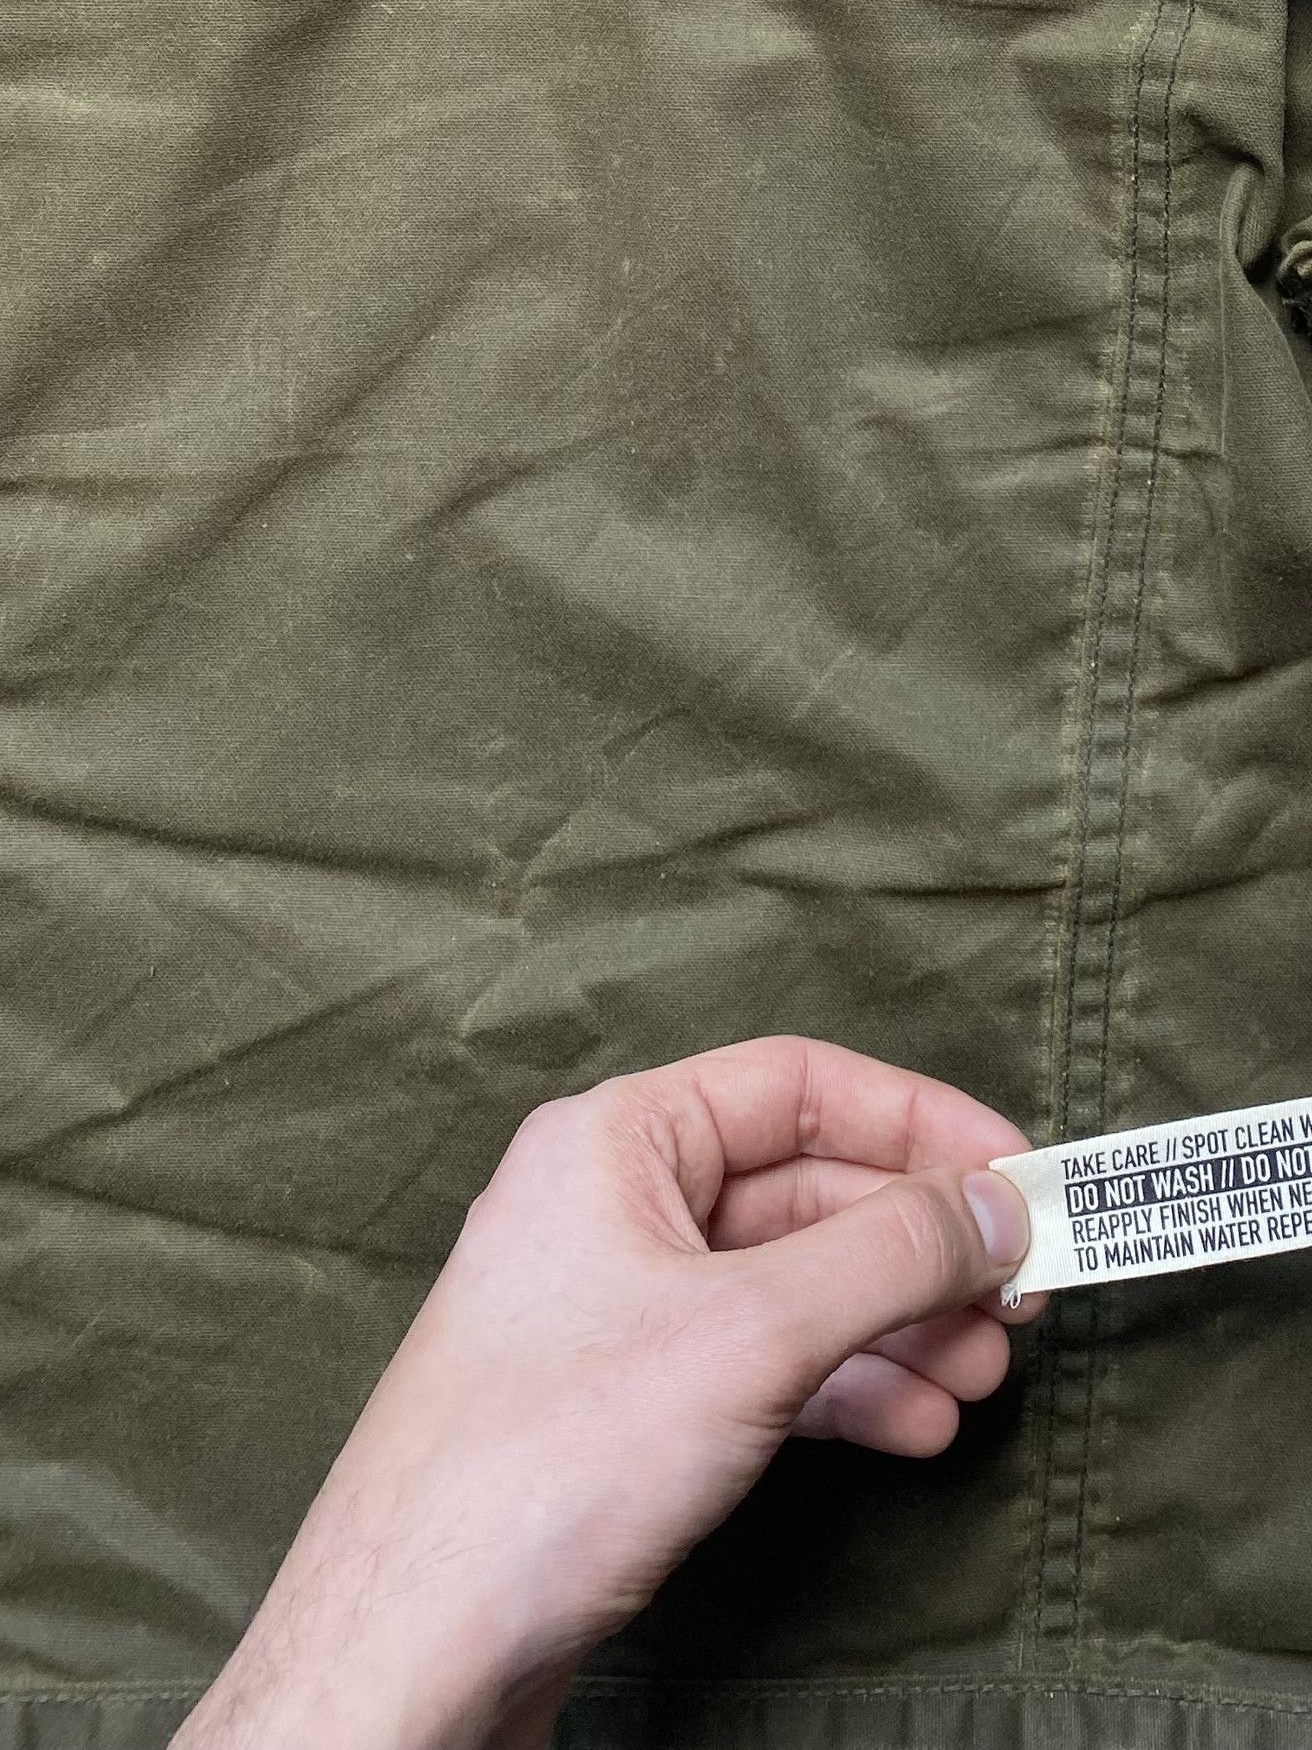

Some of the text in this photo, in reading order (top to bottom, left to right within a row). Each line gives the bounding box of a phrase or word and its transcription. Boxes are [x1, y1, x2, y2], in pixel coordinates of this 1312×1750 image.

[1061, 1152, 1107, 1180] TAKE
[1111, 1141, 1161, 1171] CARE
[1165, 1137, 1178, 1163] //
[1181, 1129, 1229, 1160] SPOT
[1235, 1117, 1295, 1150] CLEAN
[1068, 1183, 1099, 1215] DO
[1104, 1174, 1147, 1208] NOT
[1150, 1162, 1215, 1200] WASH
[1220, 1157, 1235, 1189] //
[1240, 1153, 1272, 1185] DO
[1072, 1207, 1153, 1244] REAPPLY
[1159, 1196, 1223, 1231] FINISH
[1226, 1186, 1284, 1218] WHEN
[1074, 1245, 1099, 1273] TO
[1103, 1230, 1195, 1269] MAINTAIN
[1198, 1219, 1263, 1254] WATER
